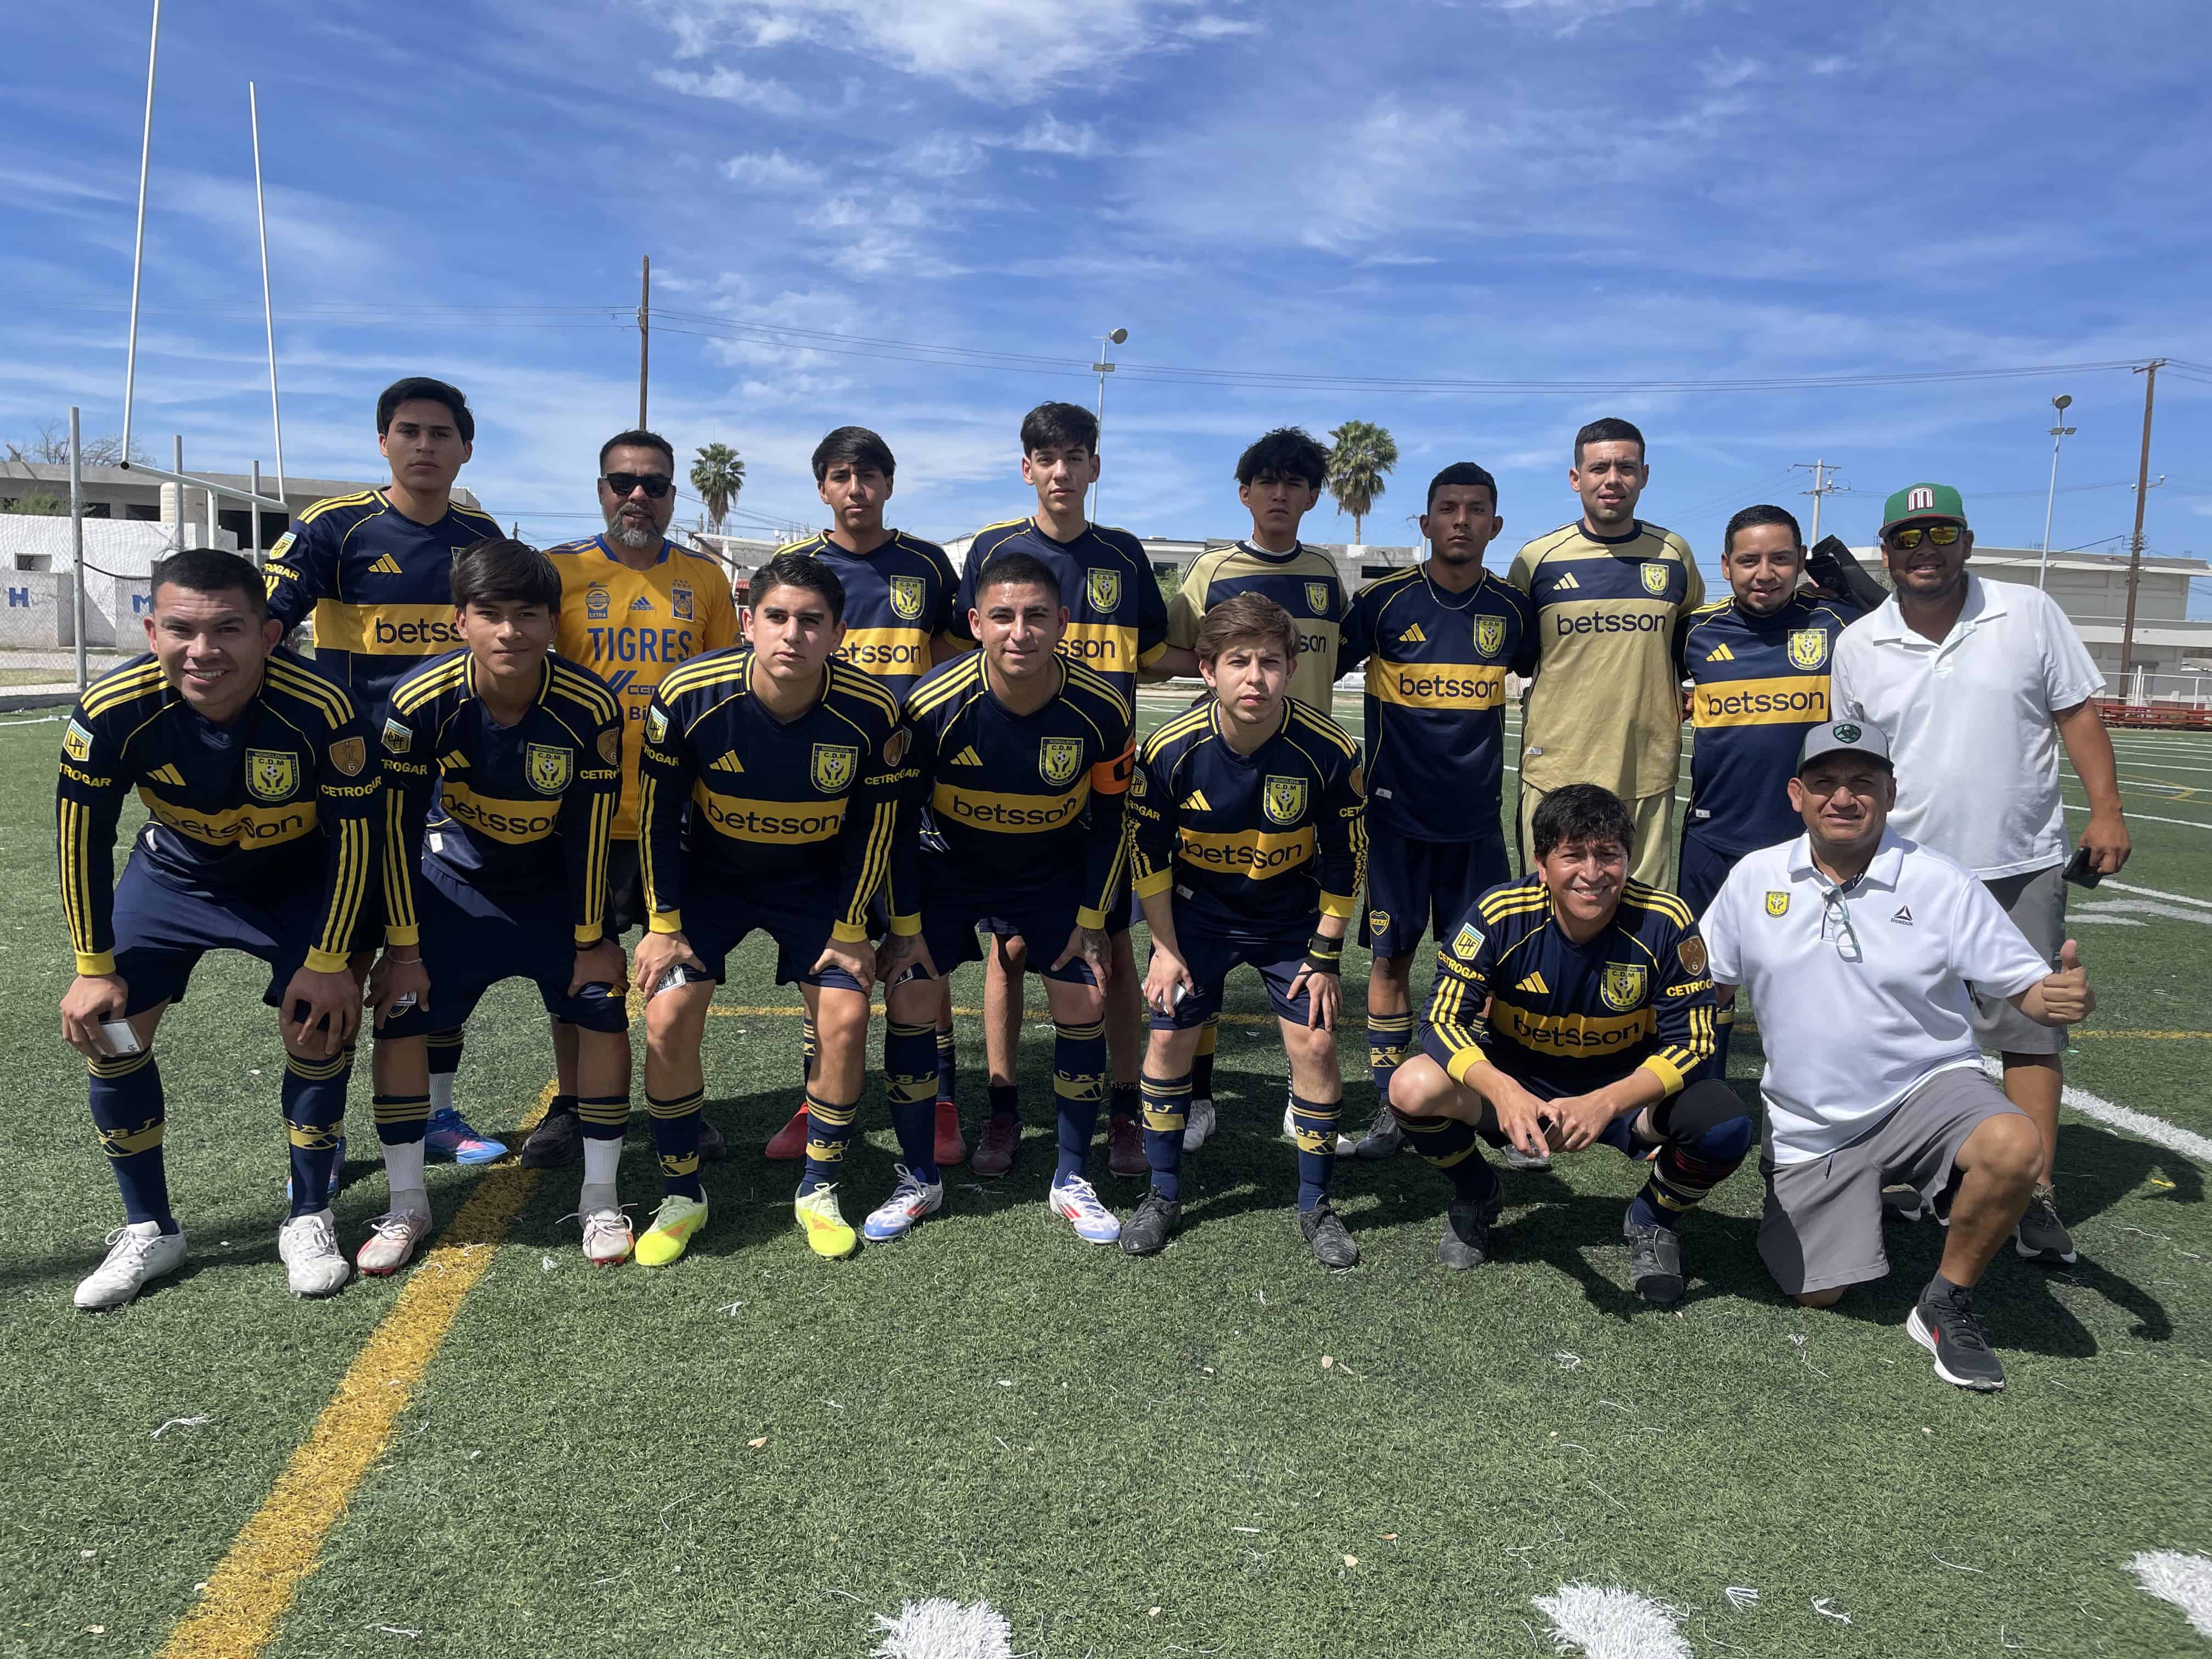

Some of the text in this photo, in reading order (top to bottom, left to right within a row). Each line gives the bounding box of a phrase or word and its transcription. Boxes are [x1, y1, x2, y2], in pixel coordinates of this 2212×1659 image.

[9, 587, 29, 607] H
[131, 595, 153, 614] M
[1556, 611, 1666, 636] betsson
[588, 627, 693, 663] TIGRES
[1400, 673, 1499, 698] betsson
[1707, 691, 1824, 716] betsson
[348, 763, 355, 771] 6
[320, 775, 382, 797] CETROGAR
[708, 799, 839, 836] betsson
[953, 795, 1077, 825] betsson
[1184, 839, 1302, 870] betsson
[1891, 917, 1914, 927] Reebok
[1437, 950, 1486, 983] CETROGAR
[1514, 1014, 1639, 1047] betsson
